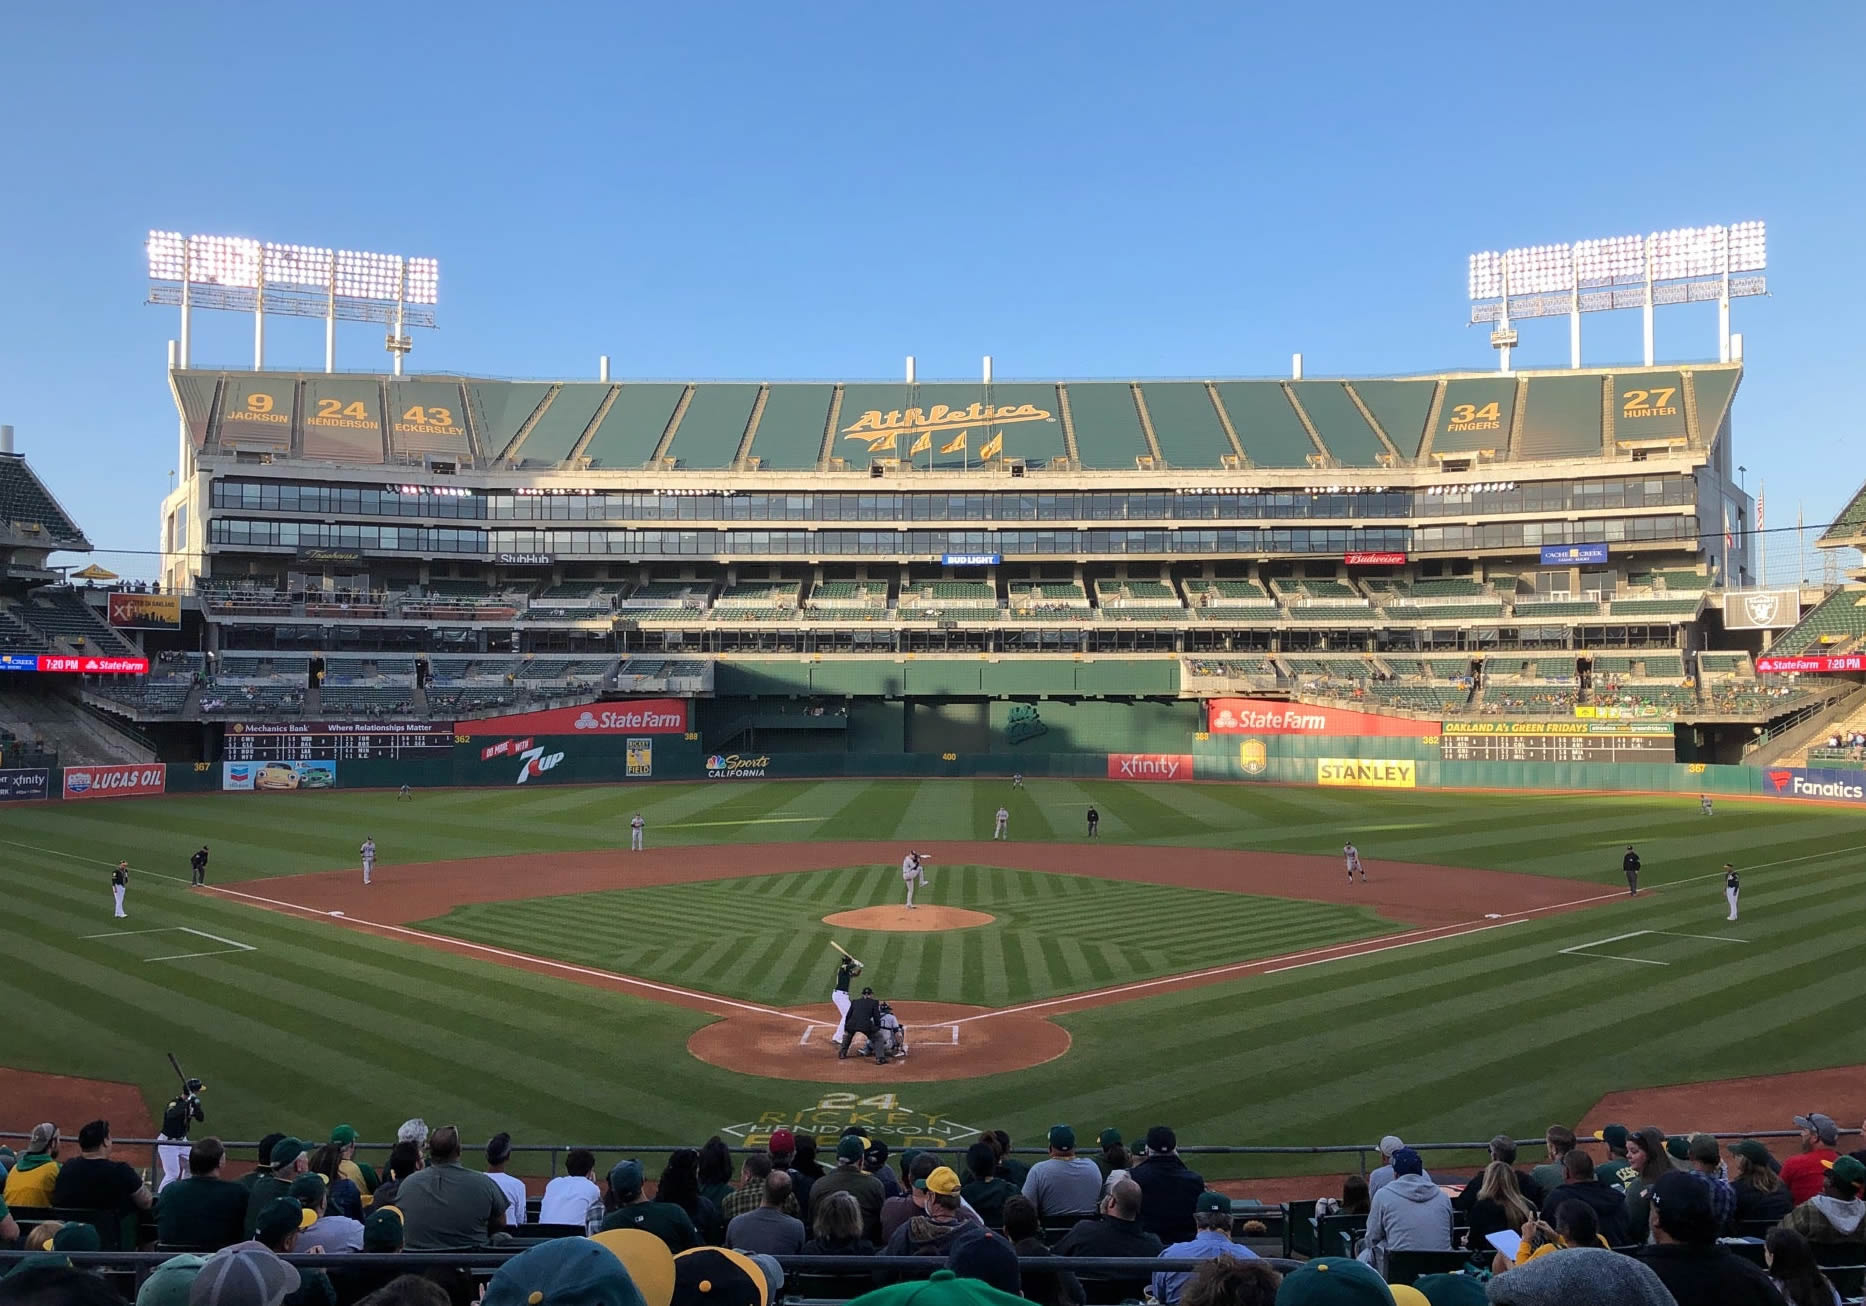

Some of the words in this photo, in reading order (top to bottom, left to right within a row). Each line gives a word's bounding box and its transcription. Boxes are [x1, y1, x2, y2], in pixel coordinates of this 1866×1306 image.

[248, 393, 274, 412] 9
[1623, 387, 1676, 410] 27
[318, 399, 368, 420] 24
[403, 405, 452, 426] 43
[1451, 402, 1500, 423] 34
[1623, 407, 1676, 418] HUNTER
[227, 411, 288, 423] JACKSON
[842, 402, 1050, 437] Athletics
[307, 417, 378, 430] HENDERSON
[394, 422, 463, 436] ECKERSLEY
[1447, 420, 1500, 432] FINGERS
[500, 553, 549, 564] StubHub
[948, 556, 967, 564] BUD
[967, 556, 994, 564] LIGHT
[1348, 553, 1402, 564] Budweiser
[46, 659, 62, 669] 7:20
[65, 659, 78, 670] PM
[1827, 660, 1844, 669] 7:20
[1846, 659, 1860, 669] PM
[245, 724, 287, 732] Mechanics
[289, 724, 309, 732] Bank
[355, 724, 405, 732] Relationships
[1446, 723, 1494, 732] OAKLAND
[1495, 723, 1510, 732] A's
[1511, 723, 1544, 732] GREEN
[1546, 723, 1588, 732] FRIDAYS
[454, 735, 470, 743] 362
[684, 732, 698, 741] 388
[1423, 736, 1439, 745] 362
[486, 747, 494, 758] DO
[515, 740, 529, 753] WITH
[725, 754, 771, 771] Sports
[942, 753, 956, 761] 400
[193, 761, 211, 772] 367
[628, 765, 649, 774] FIELD
[1120, 754, 1180, 778] xfinity
[1688, 763, 1705, 773] 367
[708, 769, 765, 778] CALIFORNIA
[1321, 764, 1410, 781] STANLEY
[12, 774, 46, 787] xfinity
[92, 771, 139, 789] LUCAS
[140, 769, 161, 786] OIL
[1793, 776, 1863, 798] Fanatics
[816, 1092, 899, 1110] 24
[758, 1111, 950, 1125] RICKEY
